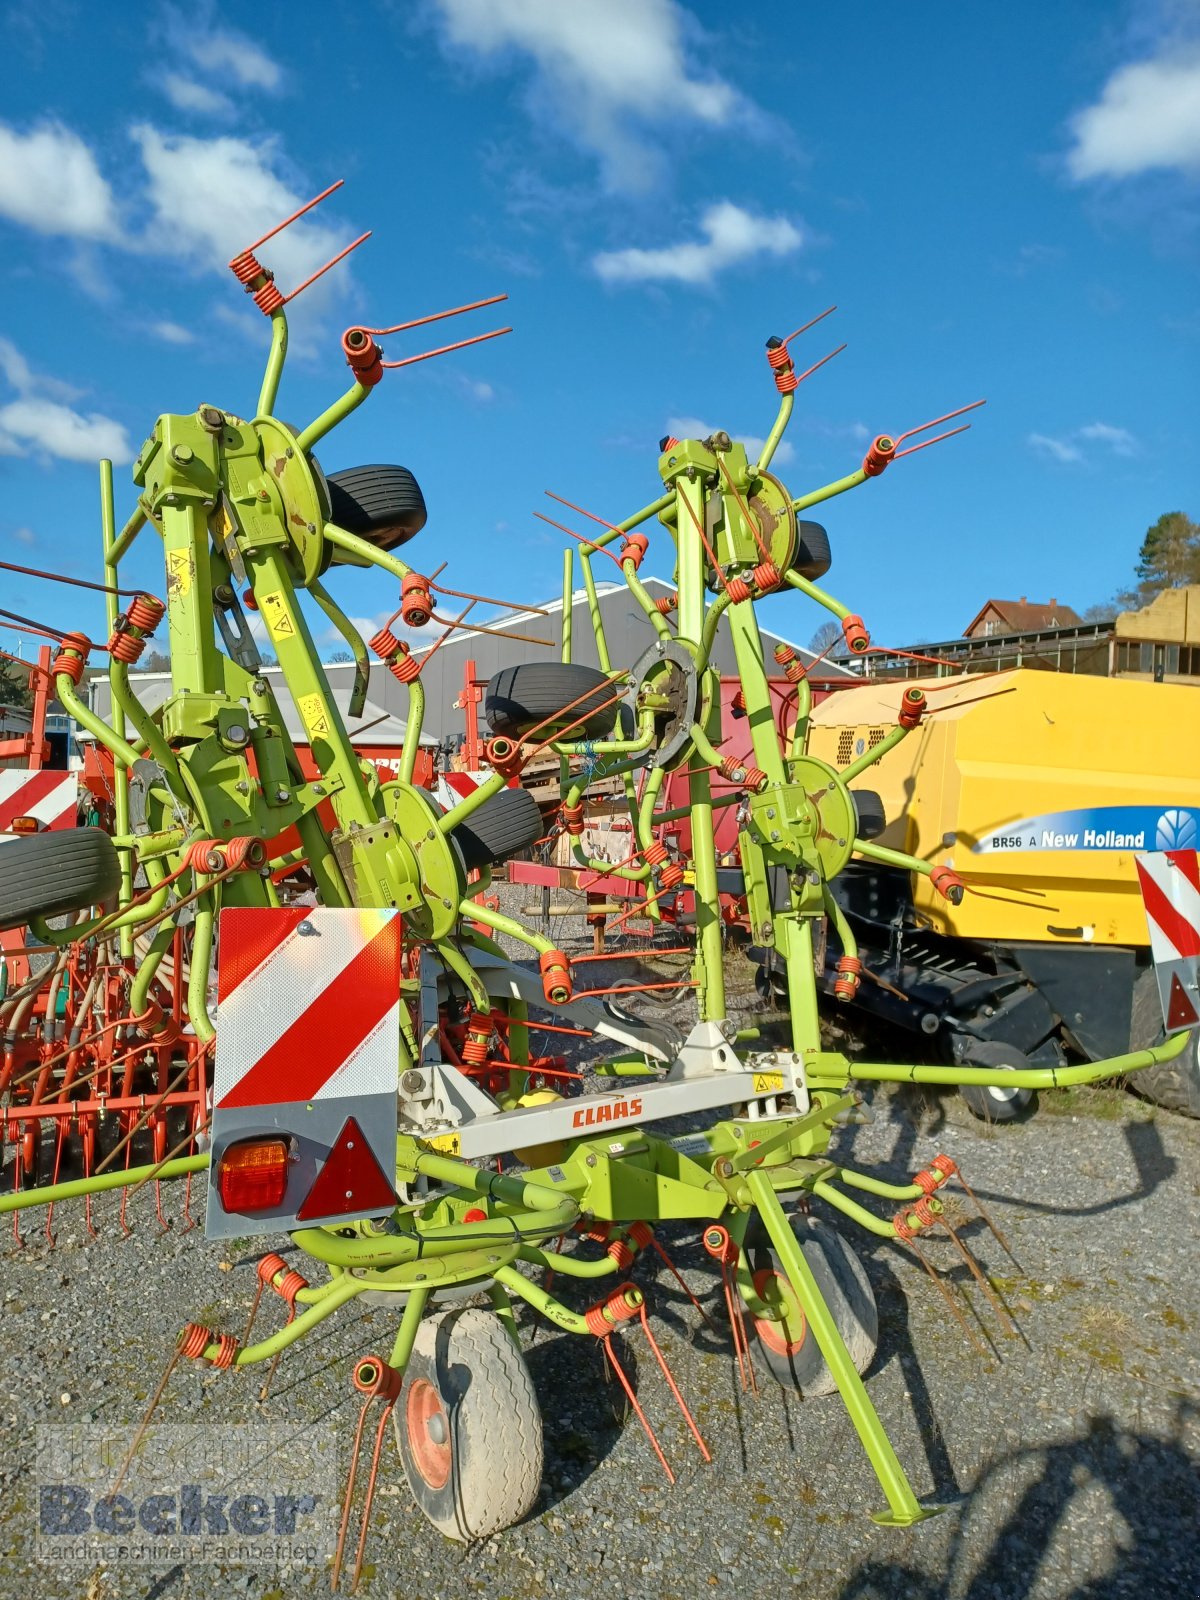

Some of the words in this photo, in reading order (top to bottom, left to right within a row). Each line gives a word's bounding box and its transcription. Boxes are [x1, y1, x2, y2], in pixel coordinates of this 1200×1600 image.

[992, 837, 1022, 848] BR56
[1029, 836, 1037, 847] A
[1041, 830, 1079, 848] New
[1083, 829, 1145, 848] Holland
[572, 1098, 643, 1128] CLAAS
